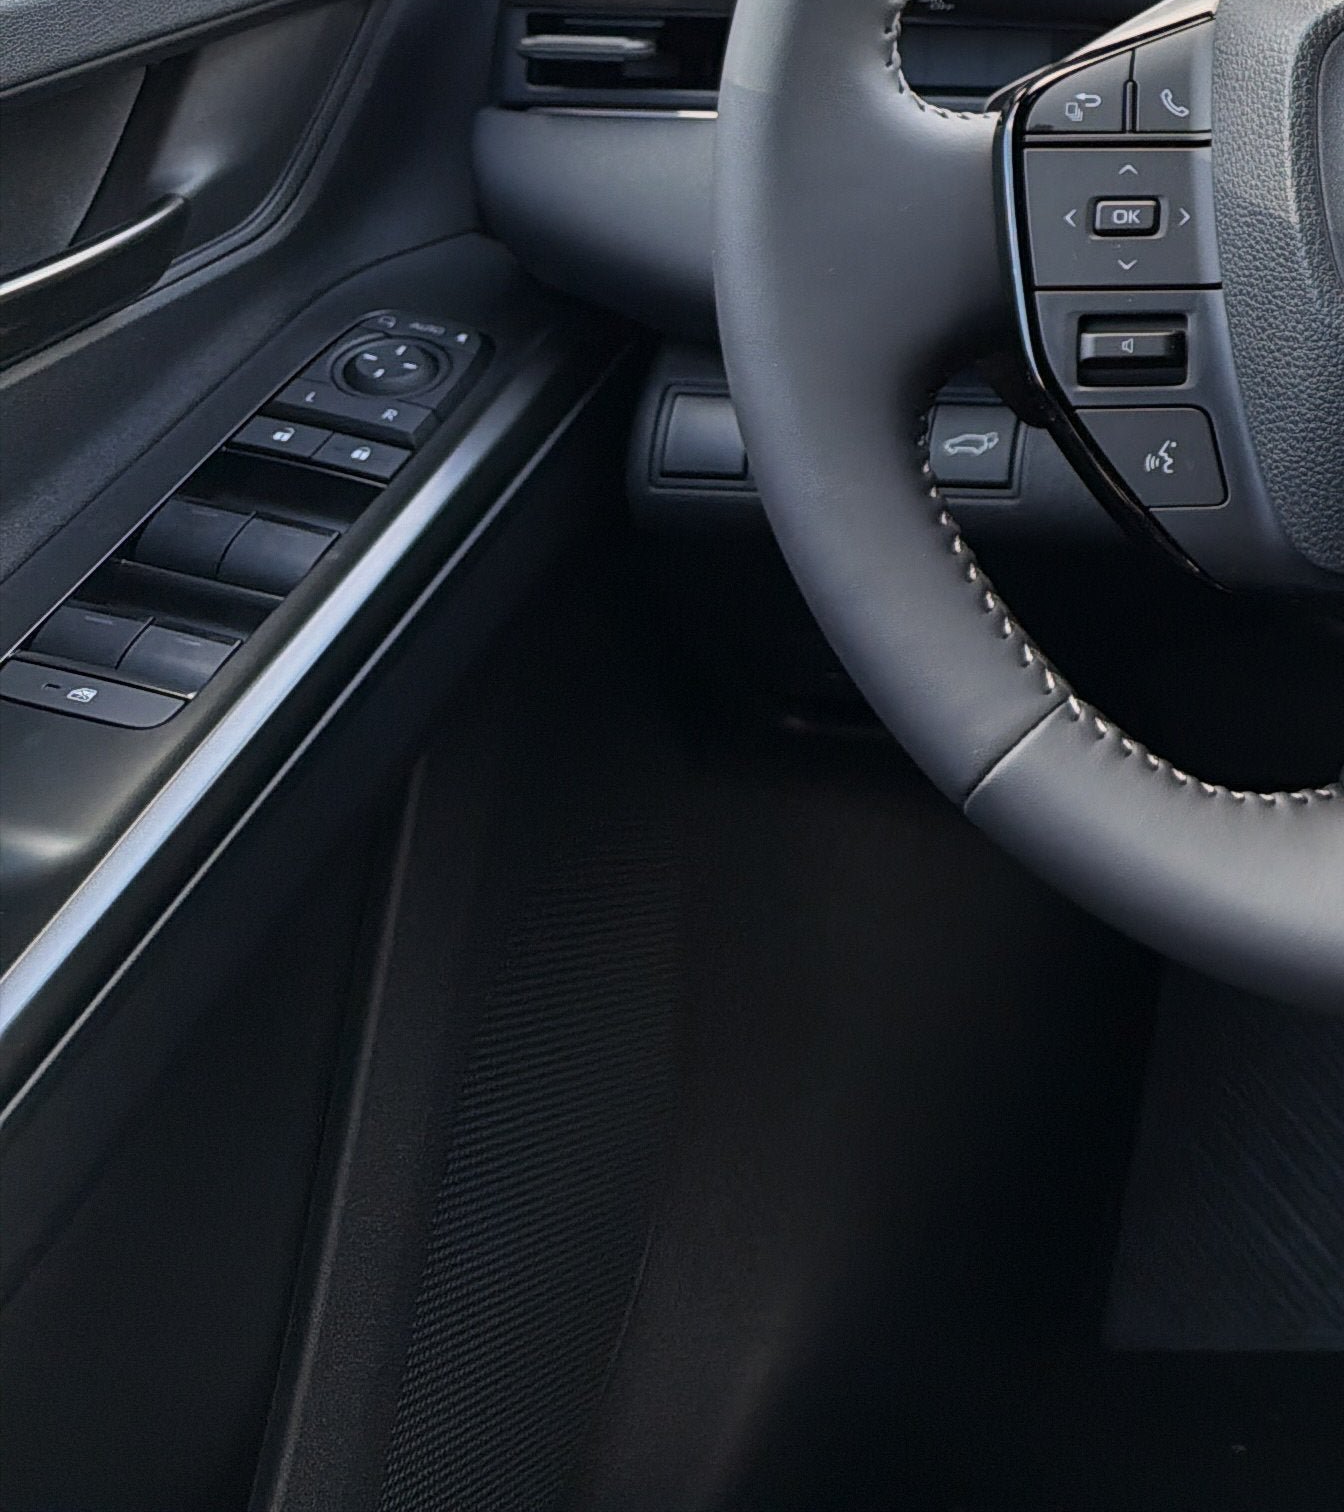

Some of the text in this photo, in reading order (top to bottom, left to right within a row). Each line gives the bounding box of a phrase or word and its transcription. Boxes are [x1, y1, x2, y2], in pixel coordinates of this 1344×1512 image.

[1112, 208, 1141, 225] OK
[306, 392, 316, 404] L
[382, 409, 398, 422] R
